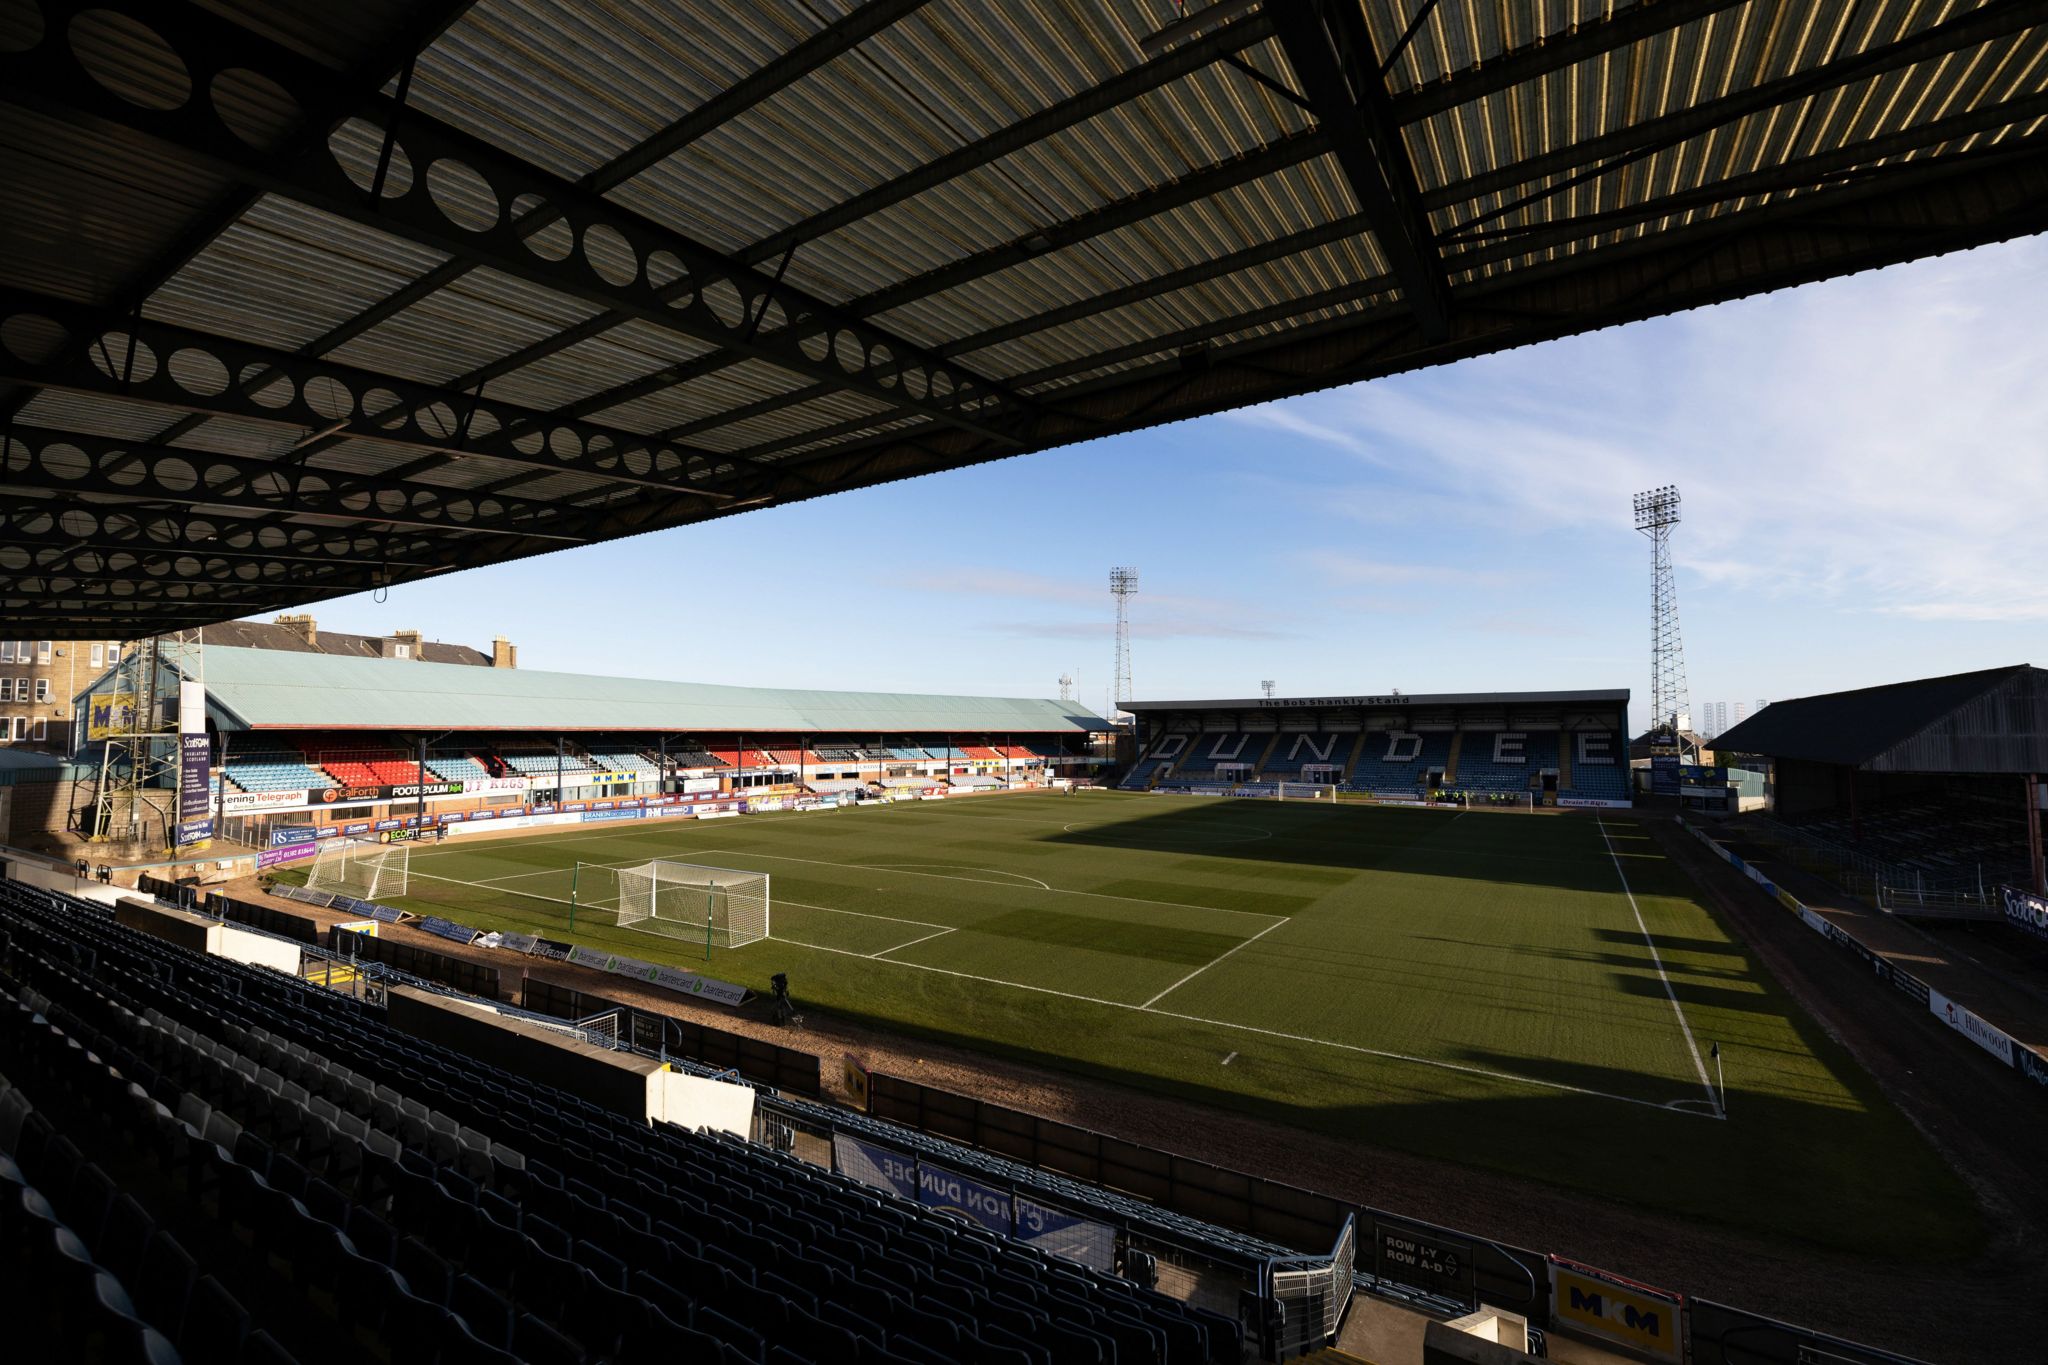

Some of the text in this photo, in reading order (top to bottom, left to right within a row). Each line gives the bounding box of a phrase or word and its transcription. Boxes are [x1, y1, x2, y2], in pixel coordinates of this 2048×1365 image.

[1258, 696, 1410, 708] The Bob Shankly Stand
[338, 787, 379, 798] CalForth
[490, 778, 524, 790] KEGS
[214, 791, 302, 805] Eening Telegraph
[390, 828, 420, 841] ECOFIT
[577, 951, 608, 967] bartercard
[616, 960, 649, 977] bartercard
[658, 969, 693, 988] bartercard
[703, 983, 742, 1002] bartercard
[1965, 1013, 2009, 1054] Hillwood
[1386, 1236, 1437, 1259] ROW I-Y
[1386, 1248, 1443, 1273] ROW A-D
[1570, 1286, 1659, 1336] MKM
